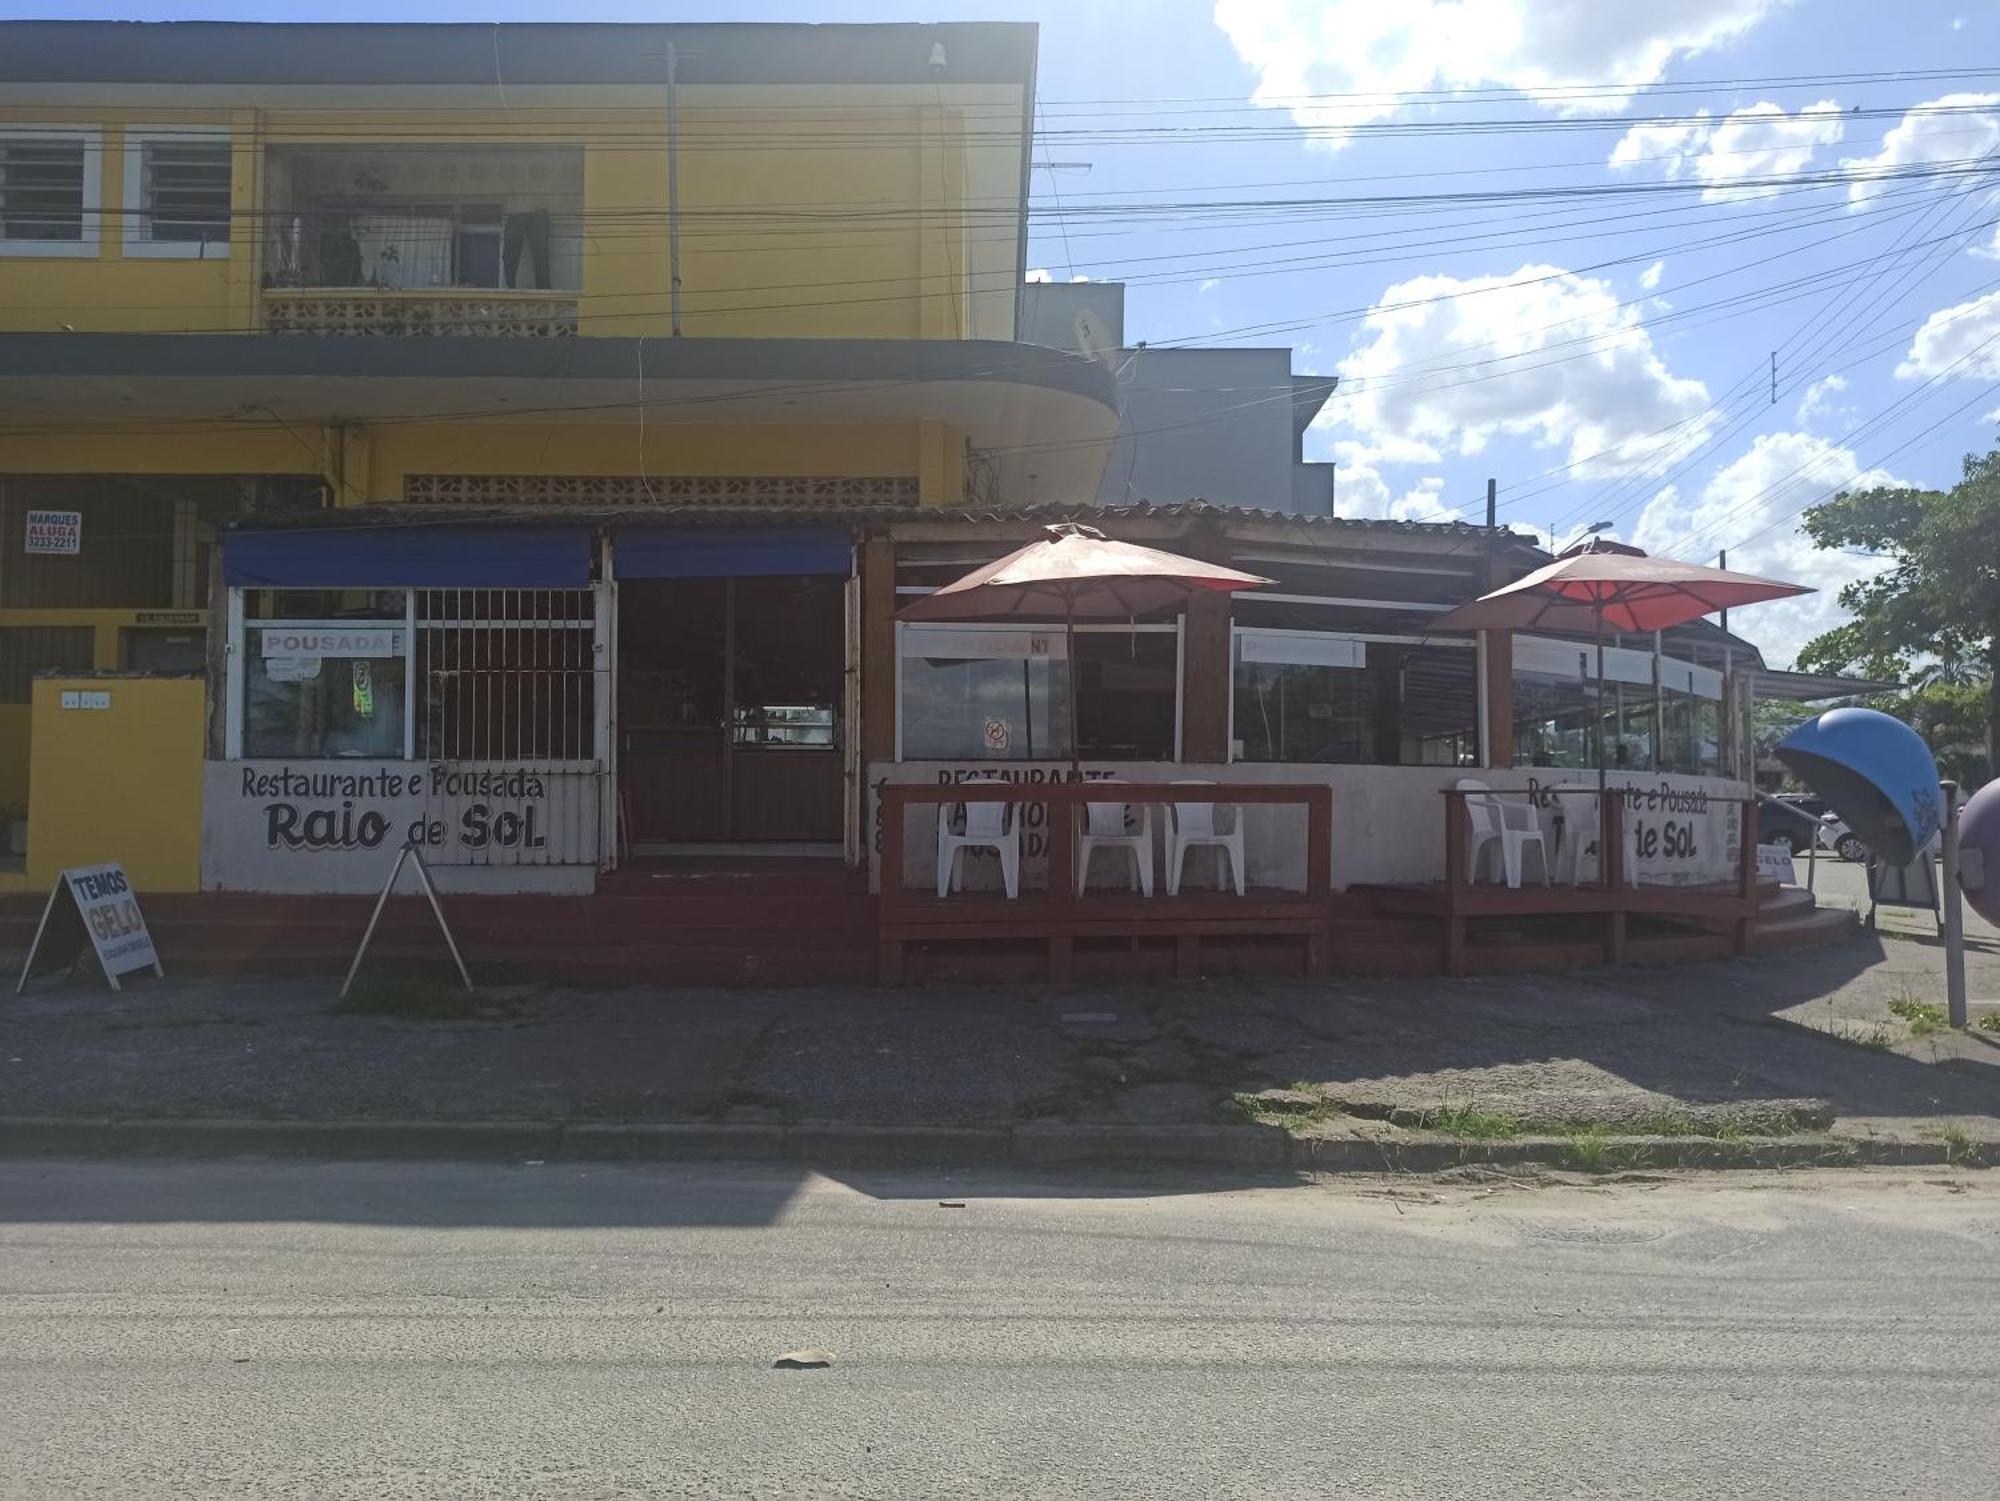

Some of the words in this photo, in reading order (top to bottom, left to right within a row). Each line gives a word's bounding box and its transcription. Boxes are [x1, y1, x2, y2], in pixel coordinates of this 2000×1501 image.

[29, 512, 79, 525] MARQUES
[29, 525, 76, 537] ALUGA
[267, 635, 388, 651] POUSADA
[242, 766, 402, 798] Restaurante
[408, 774, 421, 796] e
[431, 766, 546, 799] Pousada
[1661, 781, 1708, 815] Pousada
[265, 801, 391, 849] Raio
[408, 812, 447, 846] de
[72, 870, 128, 901] TEMOS
[89, 900, 142, 941] GELO
